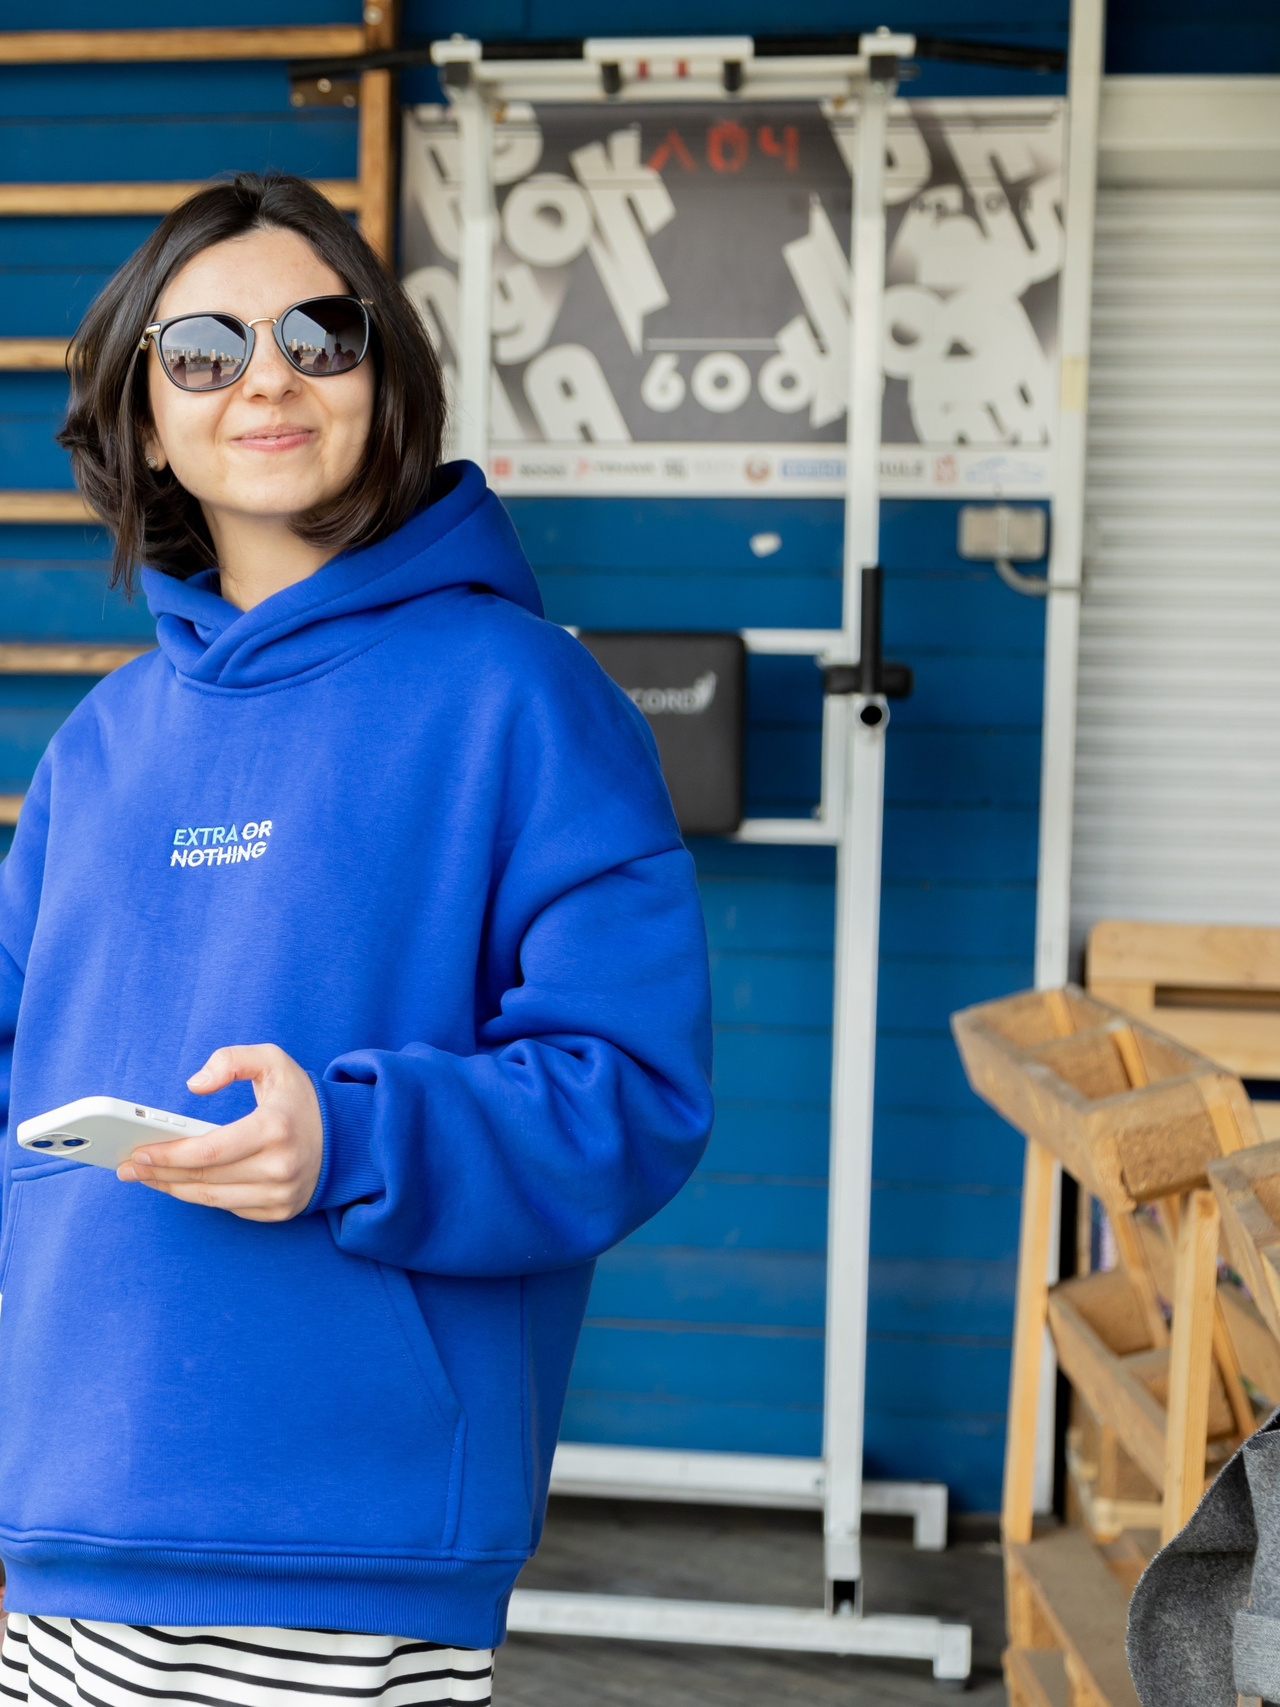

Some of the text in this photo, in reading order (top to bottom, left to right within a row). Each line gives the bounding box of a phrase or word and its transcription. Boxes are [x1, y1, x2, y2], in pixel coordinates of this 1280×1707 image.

[173, 820, 273, 847] EXTRA OR
[170, 841, 268, 868] NOTHING
